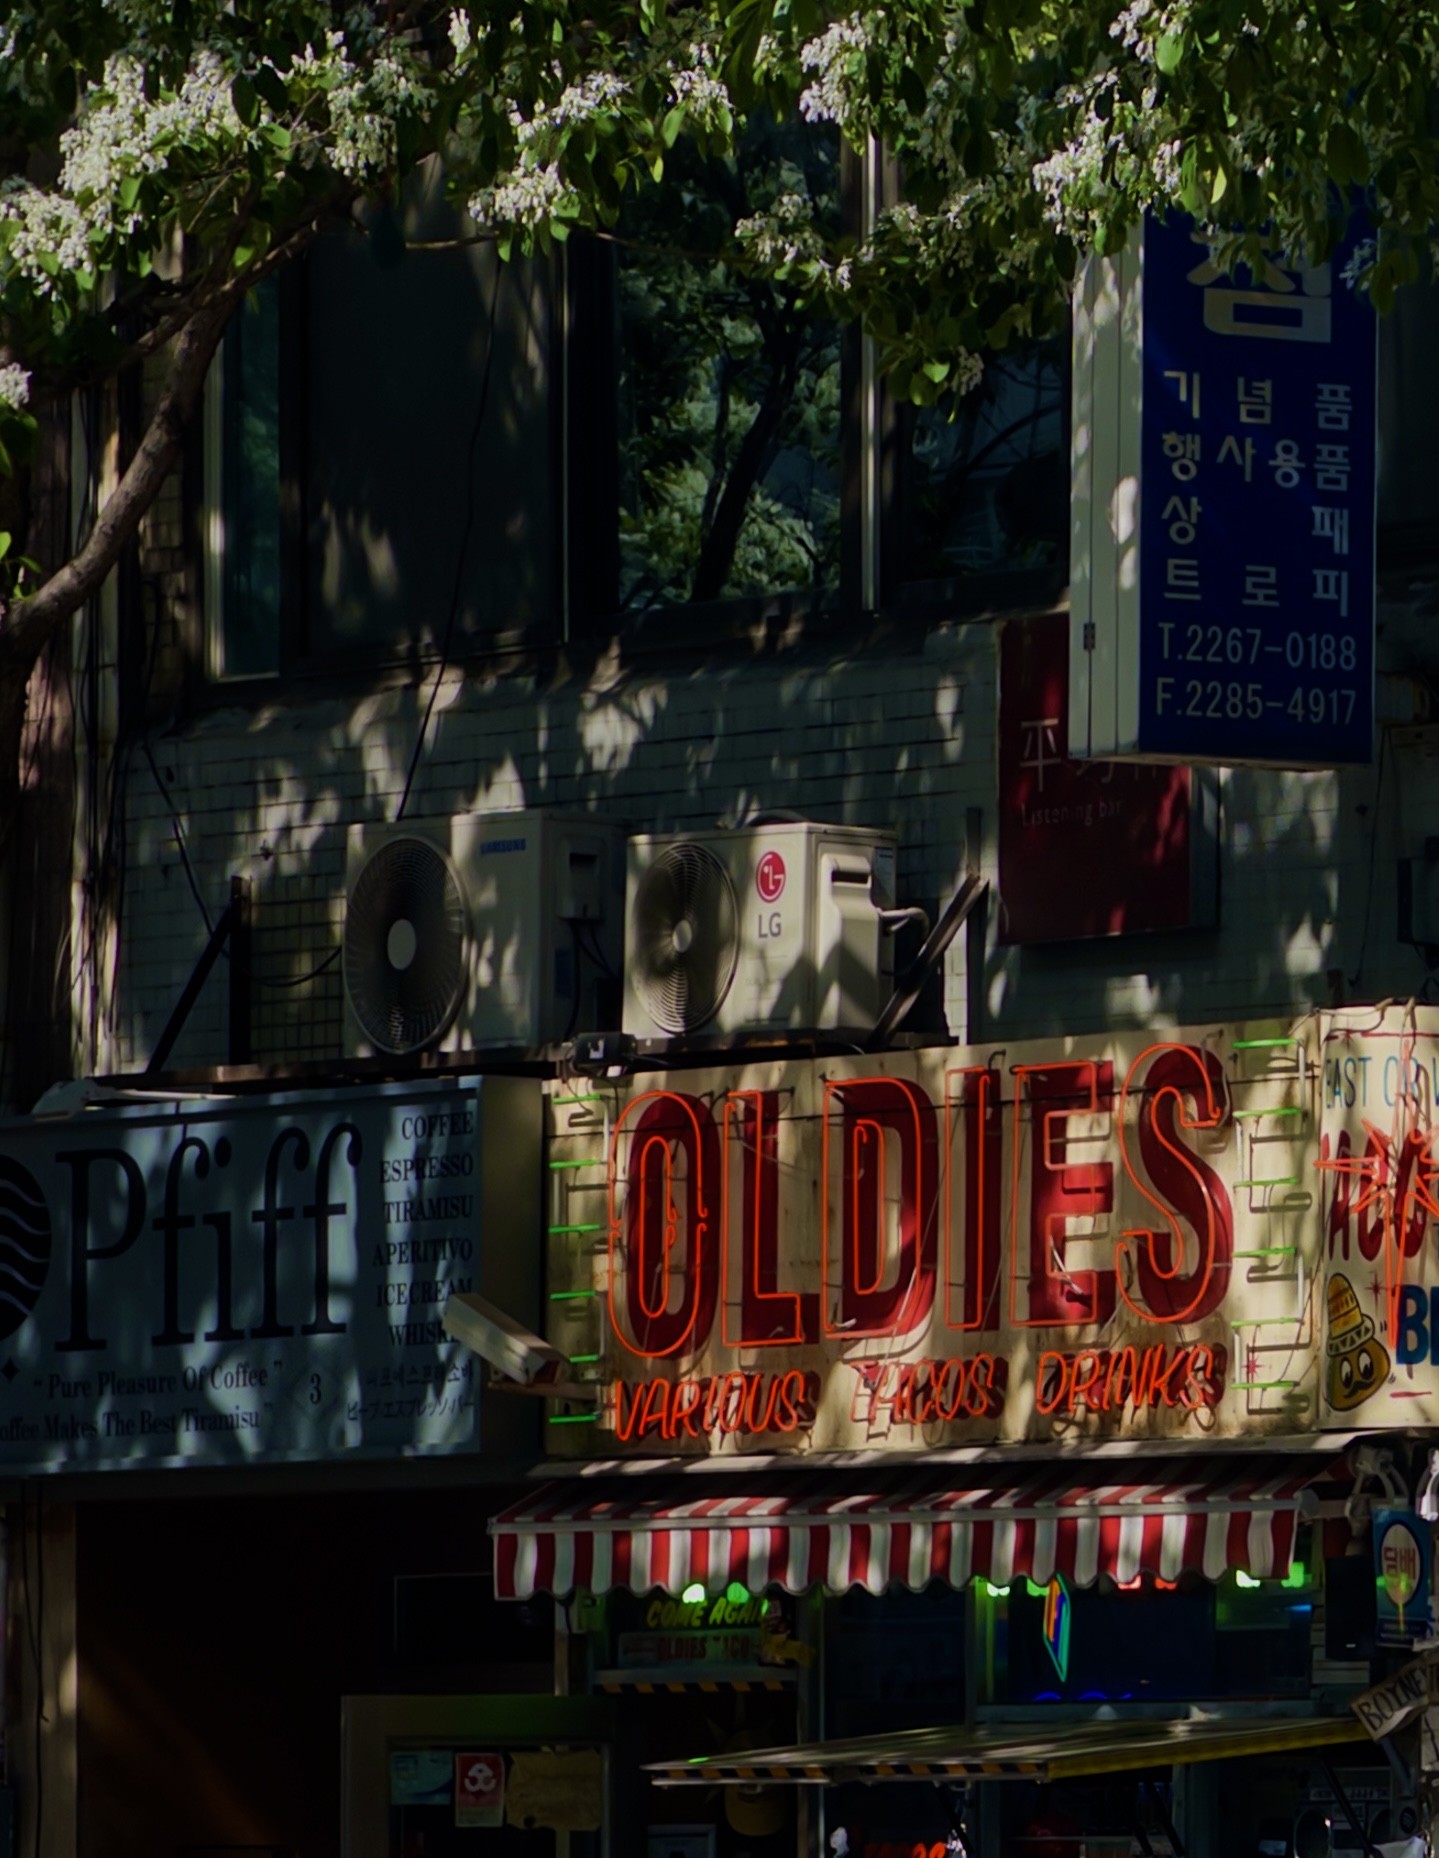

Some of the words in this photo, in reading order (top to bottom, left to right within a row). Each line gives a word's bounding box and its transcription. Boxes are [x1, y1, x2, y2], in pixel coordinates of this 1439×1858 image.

[1157, 622, 1358, 672] T.2267-0188
[1156, 676, 1357, 726] F.2285-4917
[758, 912, 782, 938] LG
[402, 1111, 474, 1140] COFFEE
[379, 1152, 474, 1184] ESPRESSO
[384, 1194, 474, 1223] TIRAMISU
[607, 1043, 1233, 1358] OLDIES
[1324, 1129, 1431, 1262] ACO
[55, 1122, 363, 1352] Pfiff
[372, 1237, 473, 1267] APERITIVO
[49, 1373, 92, 1399] Pure
[97, 1371, 177, 1396] Pleasure
[183, 1366, 205, 1392] Of
[210, 1362, 268, 1390] Coffee
[611, 1369, 819, 1442] VARIOUS
[1034, 1343, 1227, 1420] DRINKS
[0, 1415, 39, 1442] offee
[43, 1413, 97, 1441] Makes
[103, 1411, 135, 1437] The
[140, 1410, 176, 1435] Best
[182, 1404, 260, 1432] Tiramisu
[646, 1599, 708, 1629] COME
